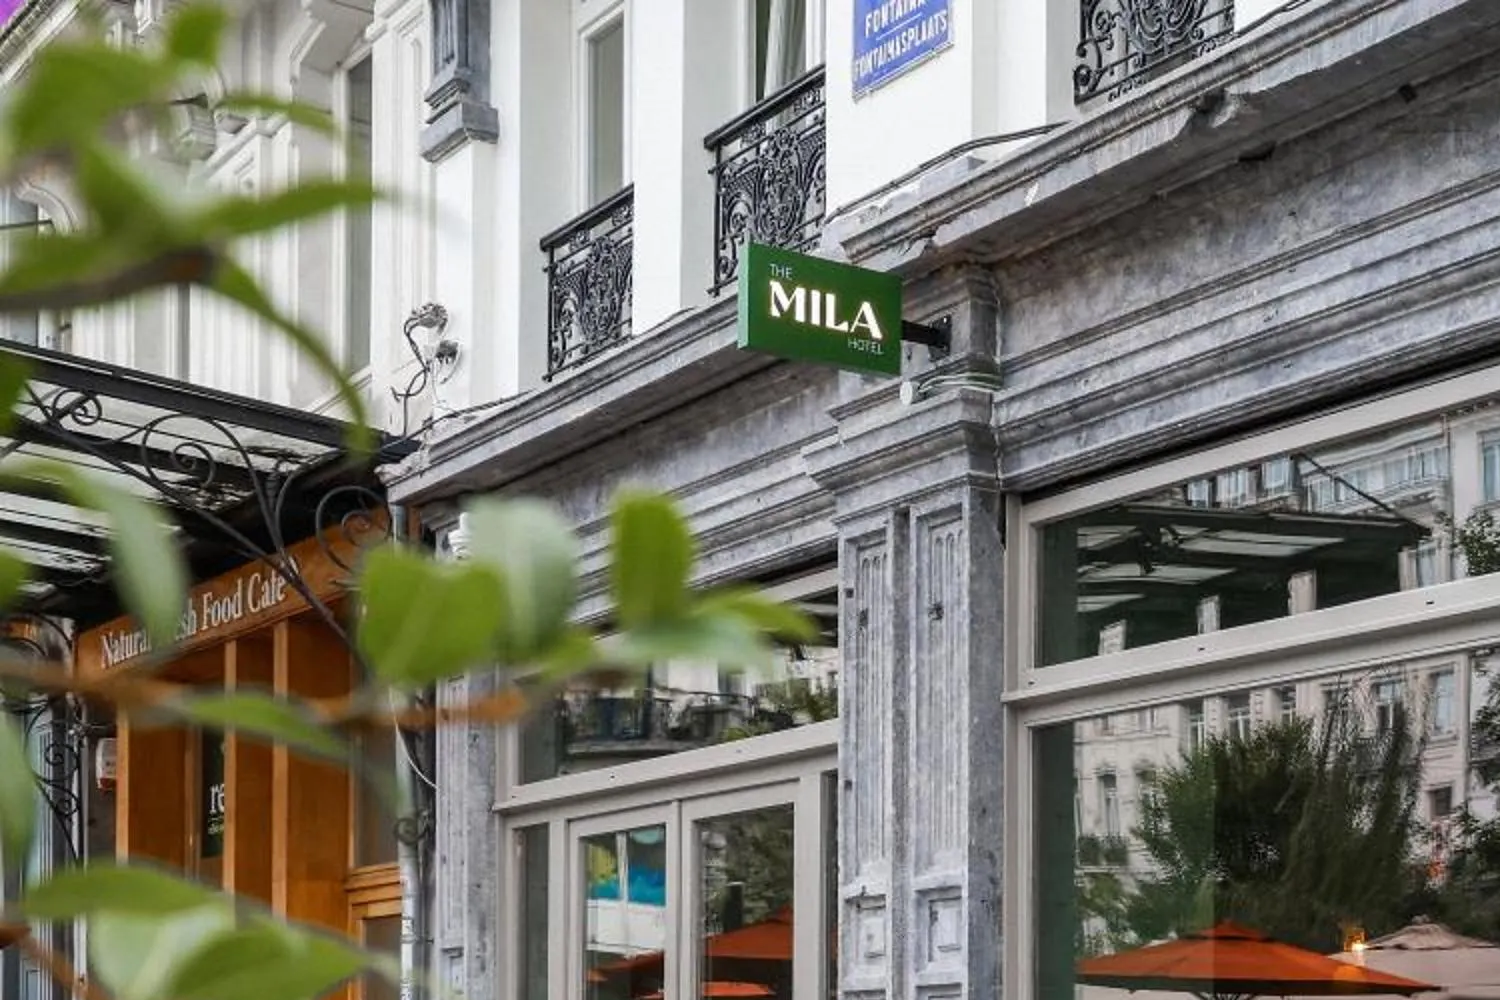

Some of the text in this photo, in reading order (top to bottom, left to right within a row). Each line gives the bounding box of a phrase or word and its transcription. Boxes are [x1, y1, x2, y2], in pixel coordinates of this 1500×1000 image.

[769, 263, 793, 281] THE
[769, 279, 883, 340] MILA
[847, 337, 884, 356] HOTEL
[202, 576, 243, 631] Food
